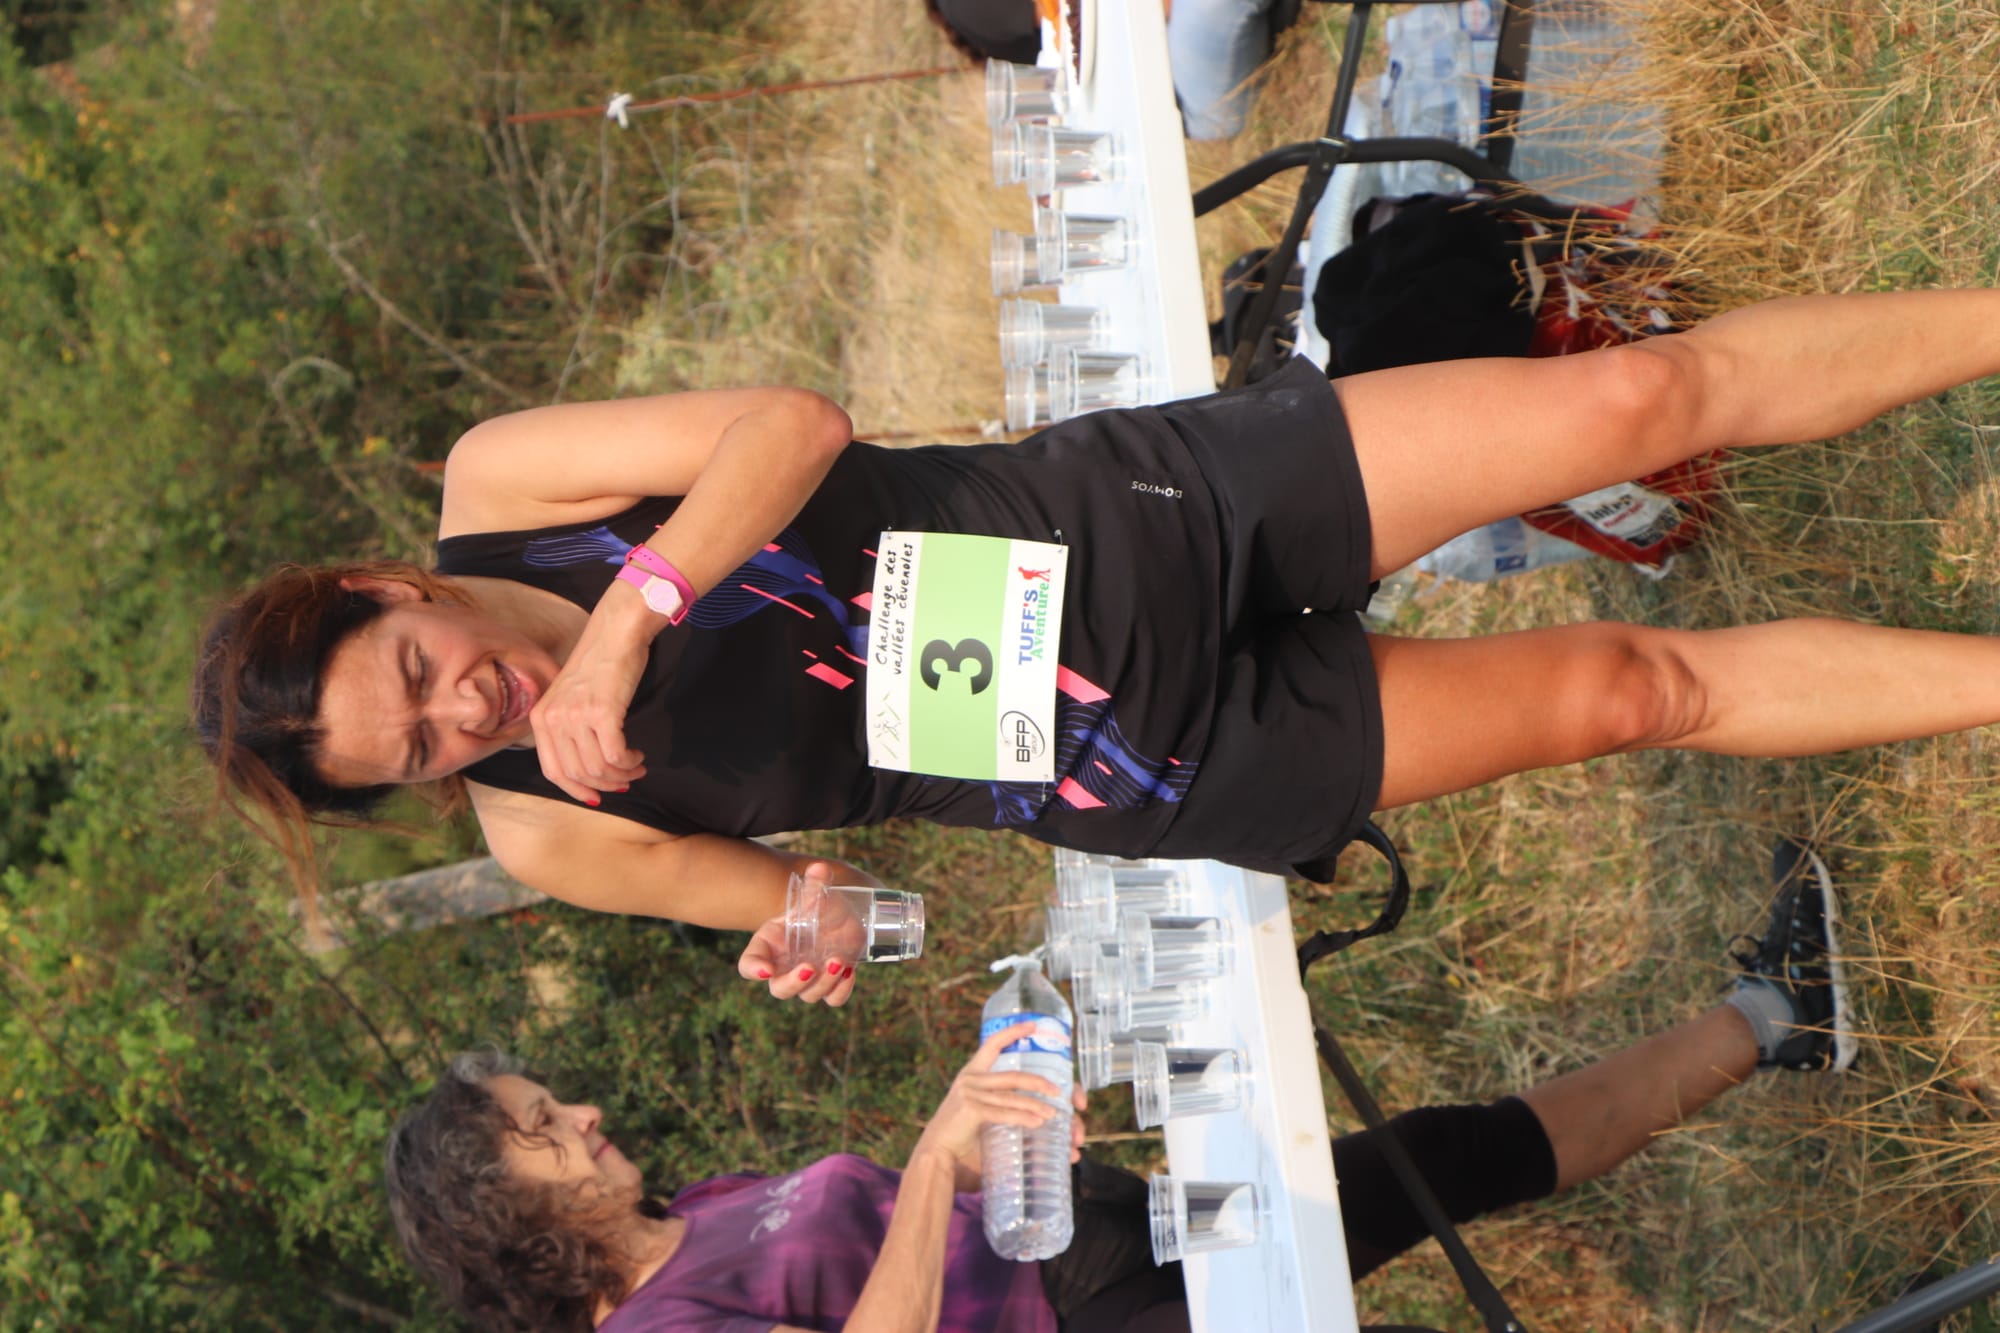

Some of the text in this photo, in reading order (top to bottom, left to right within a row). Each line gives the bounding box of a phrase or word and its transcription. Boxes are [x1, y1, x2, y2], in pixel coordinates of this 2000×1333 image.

[1131, 480, 1183, 499] DOMYOS
[875, 550, 897, 665] Challenge des
[890, 543, 913, 675] vallées cévenoles
[1018, 589, 1039, 666] TUFF'S
[1030, 582, 1050, 660] Aventure
[920, 638, 994, 695] 3
[1016, 719, 1031, 762] BFP
